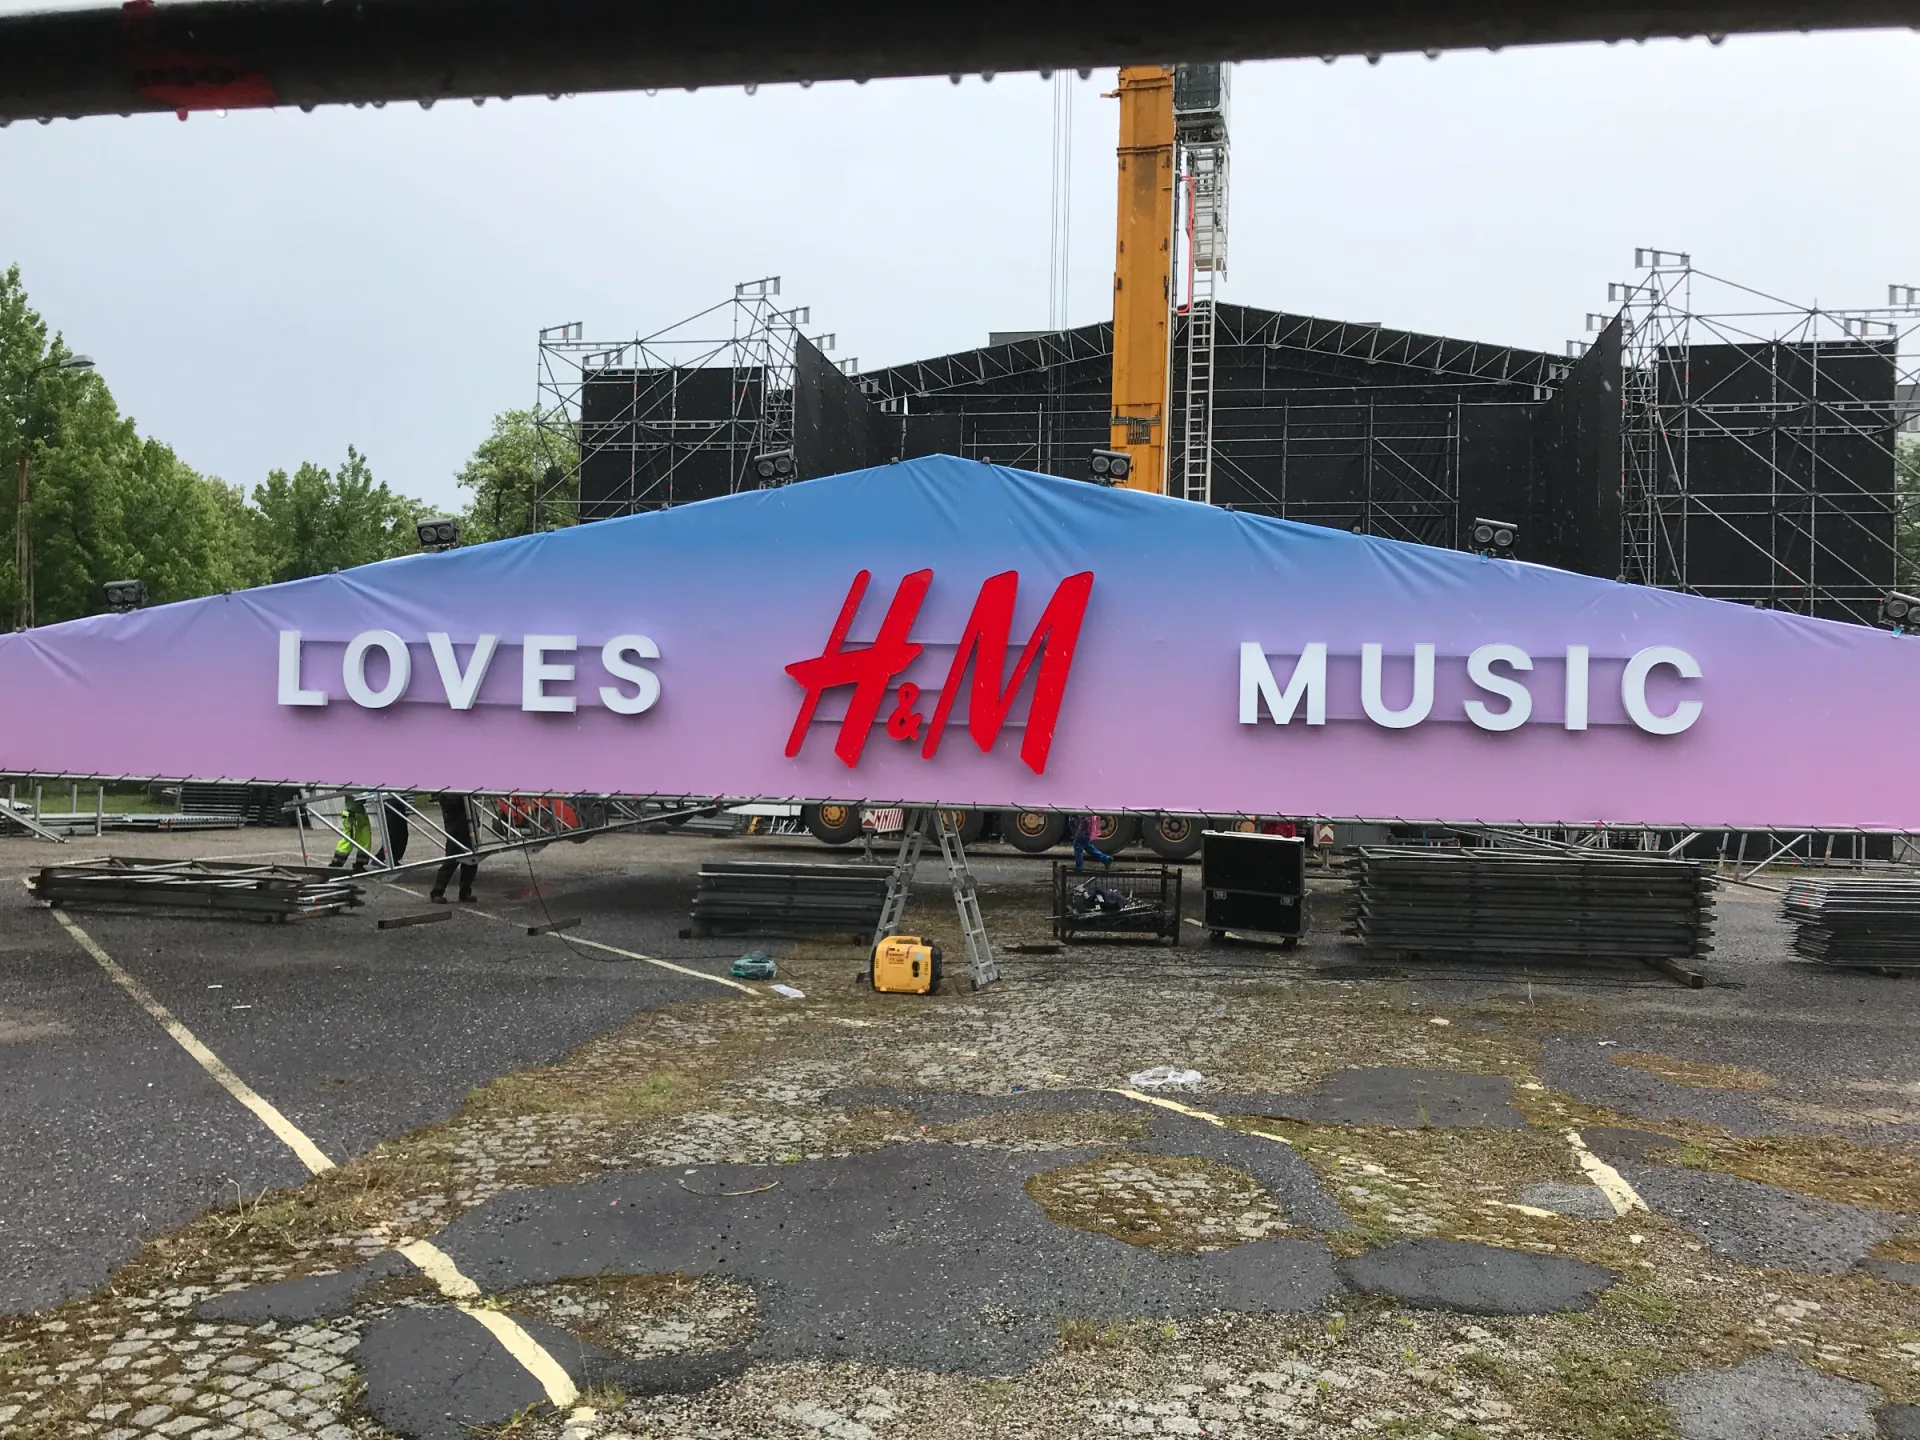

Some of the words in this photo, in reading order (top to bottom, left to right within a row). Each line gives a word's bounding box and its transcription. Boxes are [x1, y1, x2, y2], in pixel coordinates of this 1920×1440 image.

[277, 629, 661, 715] LOVES
[785, 569, 1095, 776] H&M
[1238, 641, 1704, 736] MUSIC
